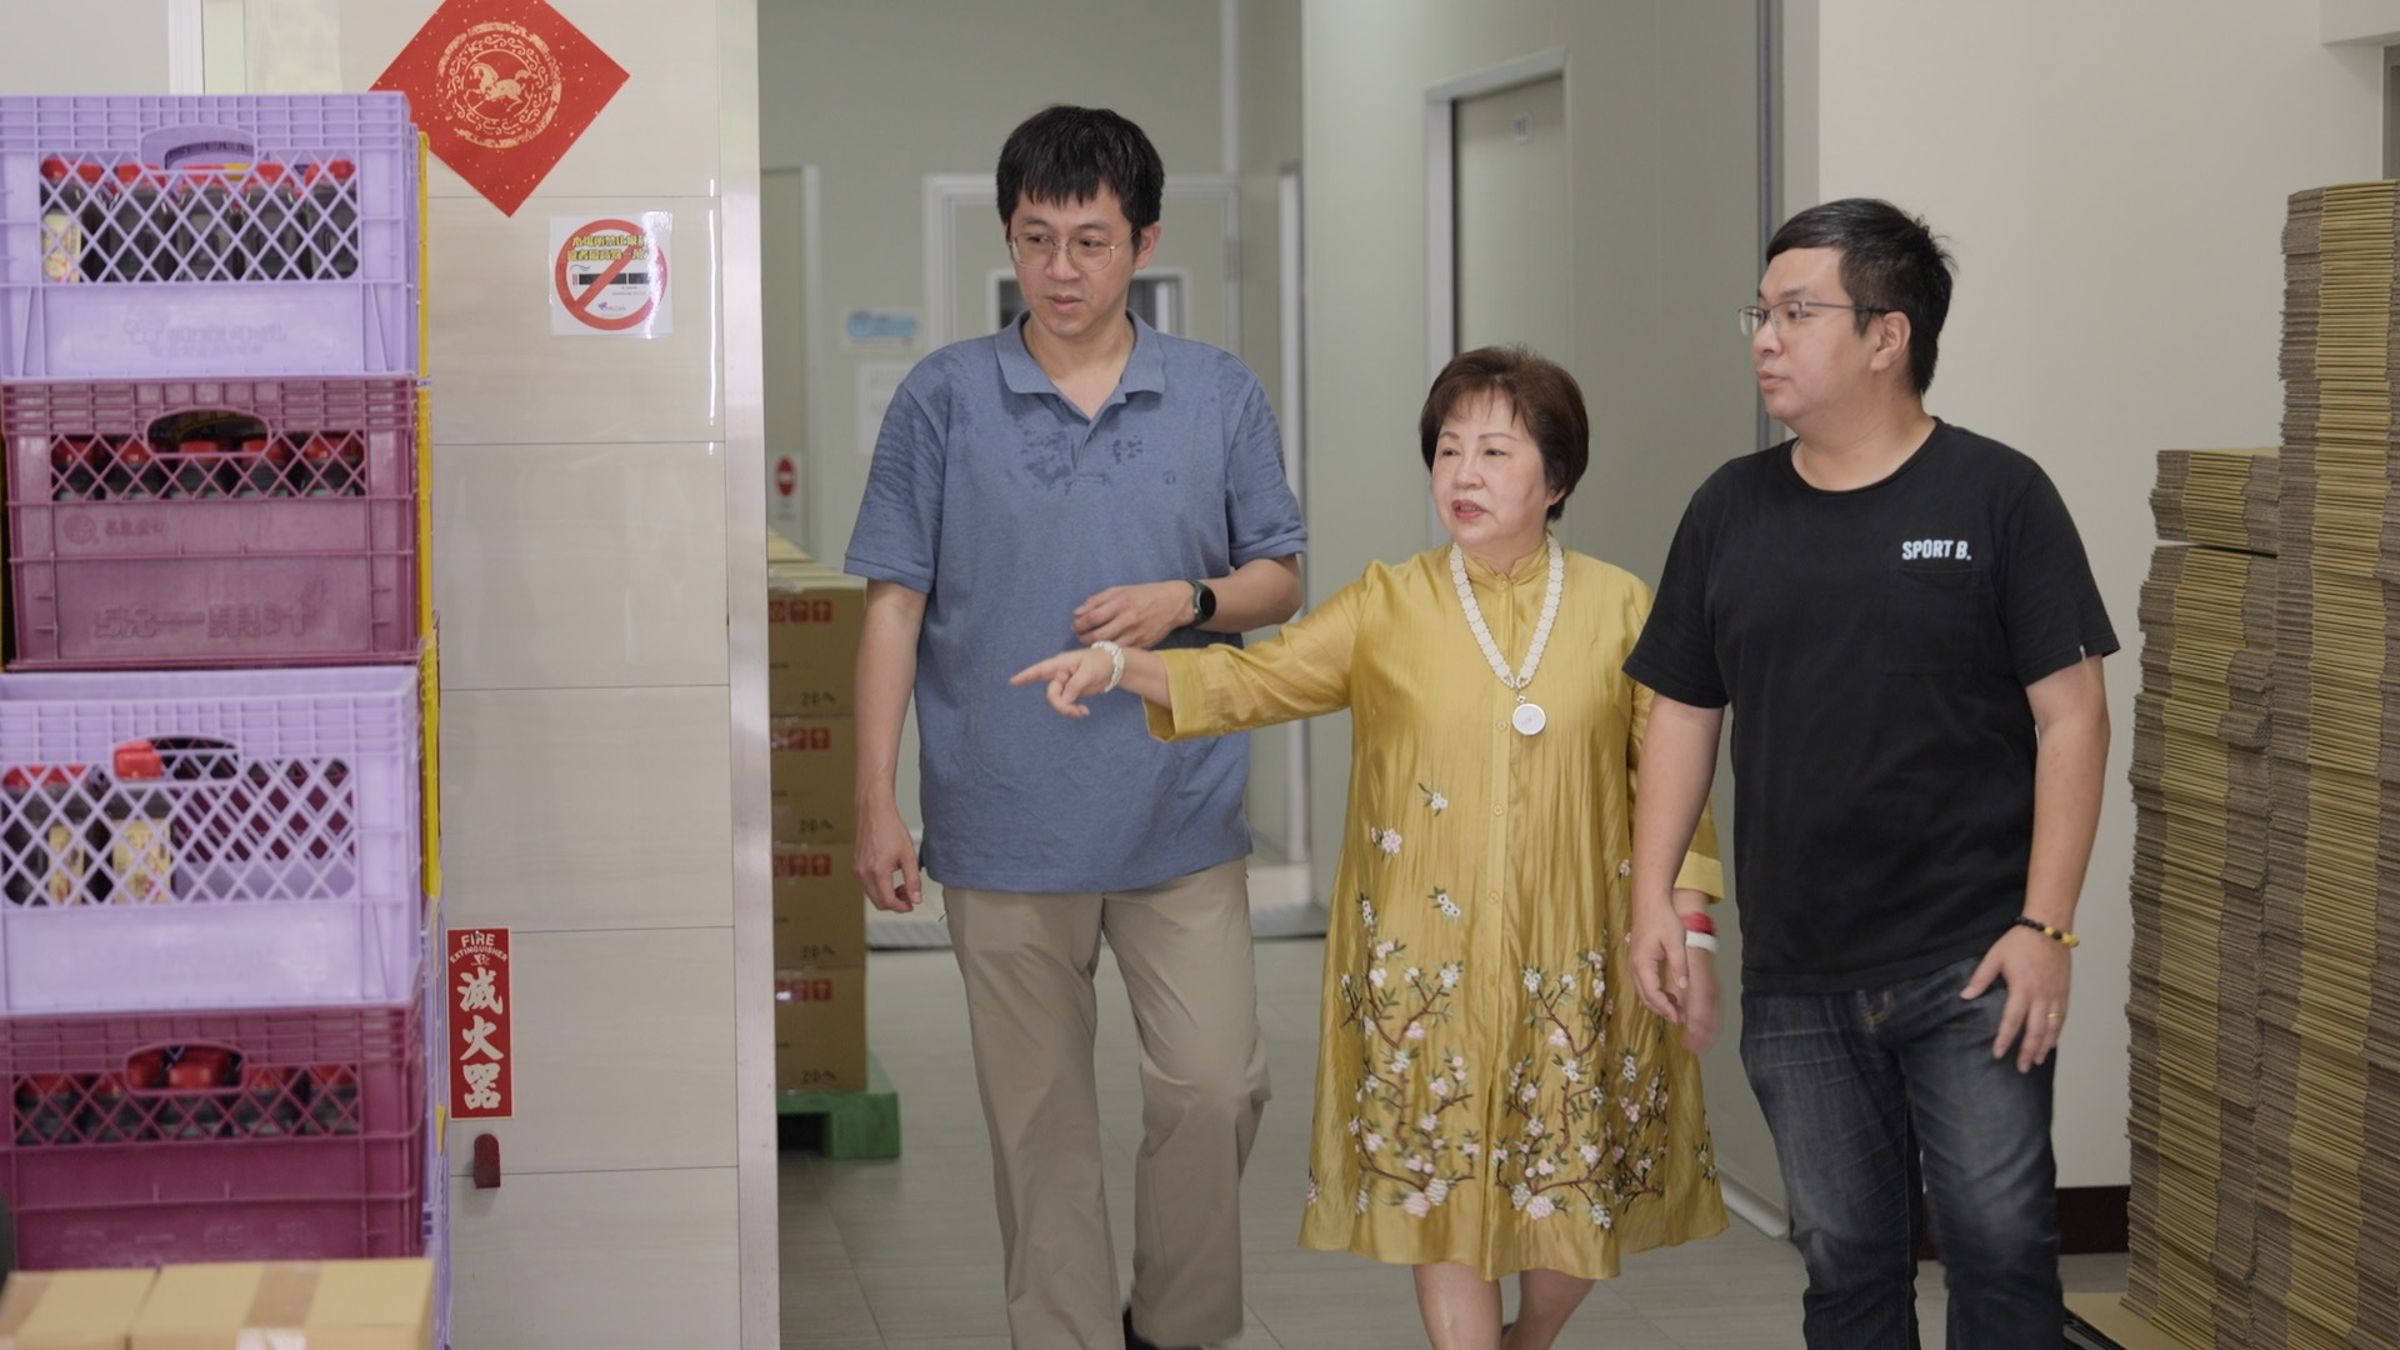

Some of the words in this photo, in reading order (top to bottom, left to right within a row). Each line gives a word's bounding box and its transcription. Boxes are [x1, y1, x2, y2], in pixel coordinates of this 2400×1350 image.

[1902, 539, 1954, 560] SPORT
[1955, 540, 1972, 561] B.
[461, 933, 496, 948] FIRE
[450, 946, 508, 964] EXTINGUISHER
[457, 967, 504, 1110] 滅火器
